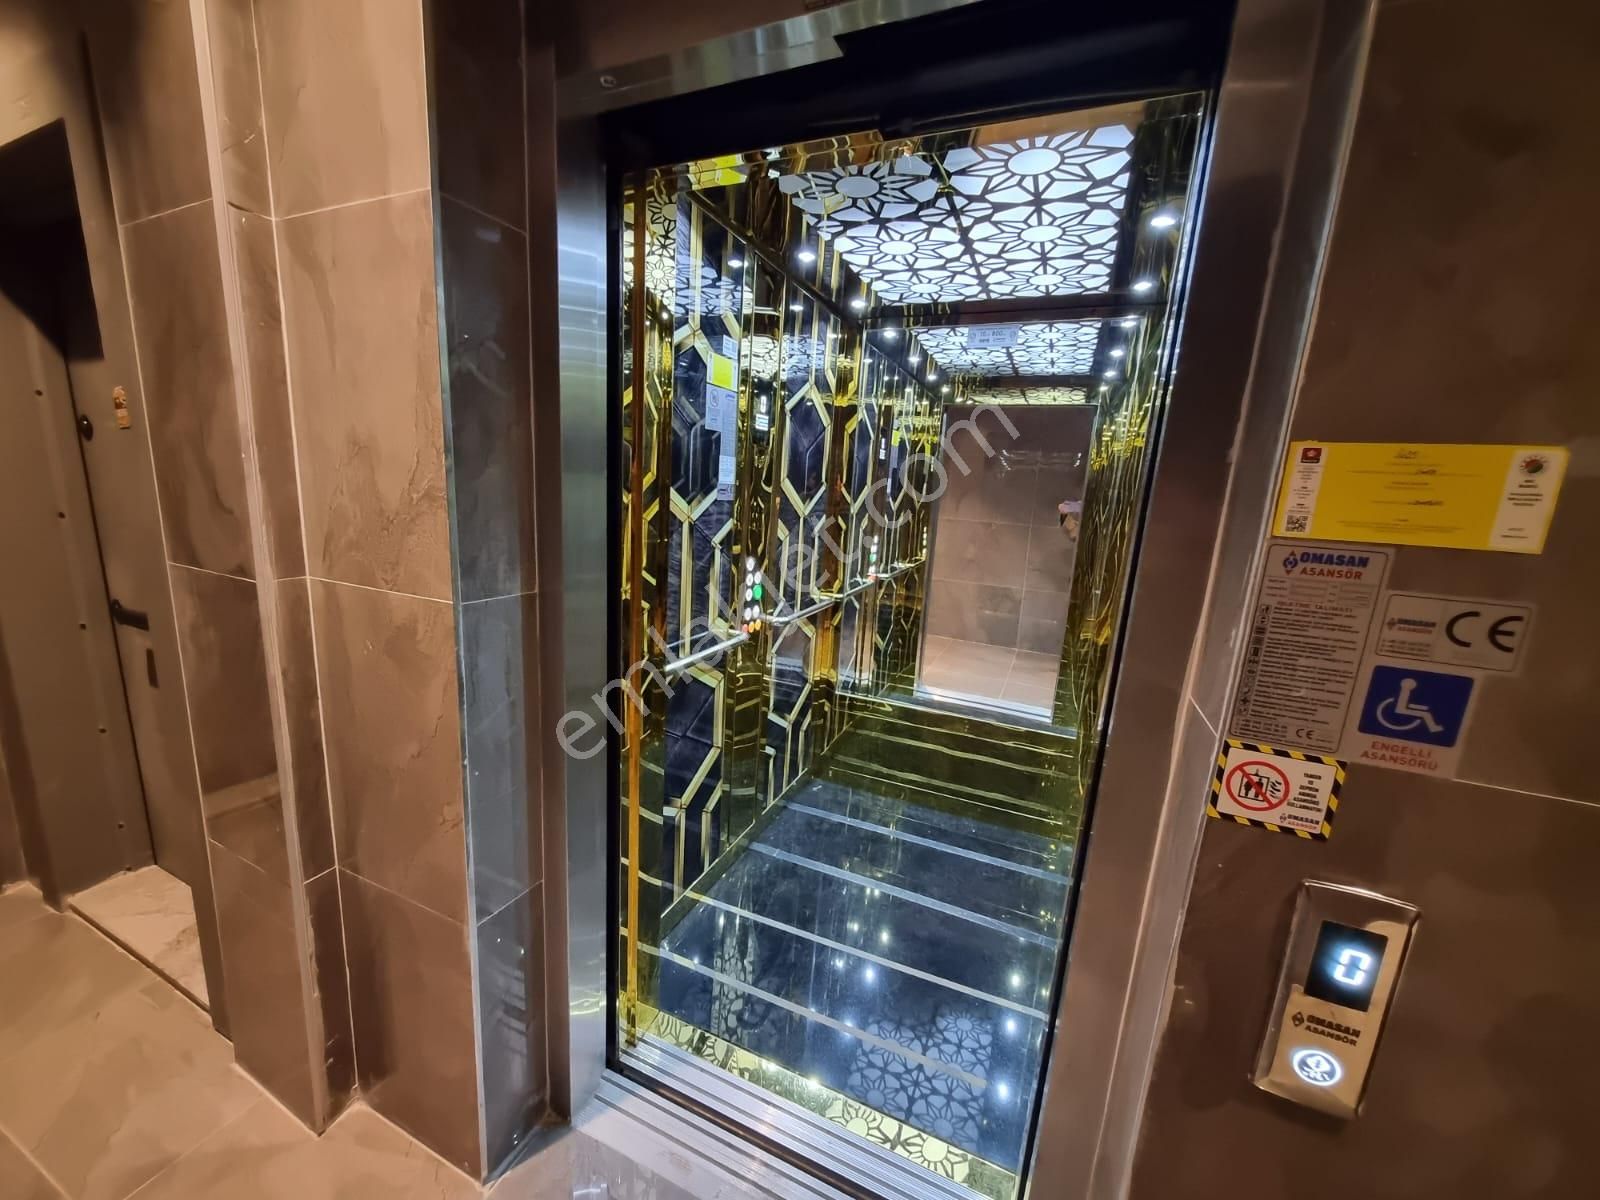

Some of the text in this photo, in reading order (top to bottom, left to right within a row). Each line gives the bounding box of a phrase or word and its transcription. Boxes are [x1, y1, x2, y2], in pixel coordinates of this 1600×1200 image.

[1299, 551, 1370, 568] OMASAN
[1332, 947, 1372, 986] 0
[1305, 1013, 1362, 1038] OMASAN
